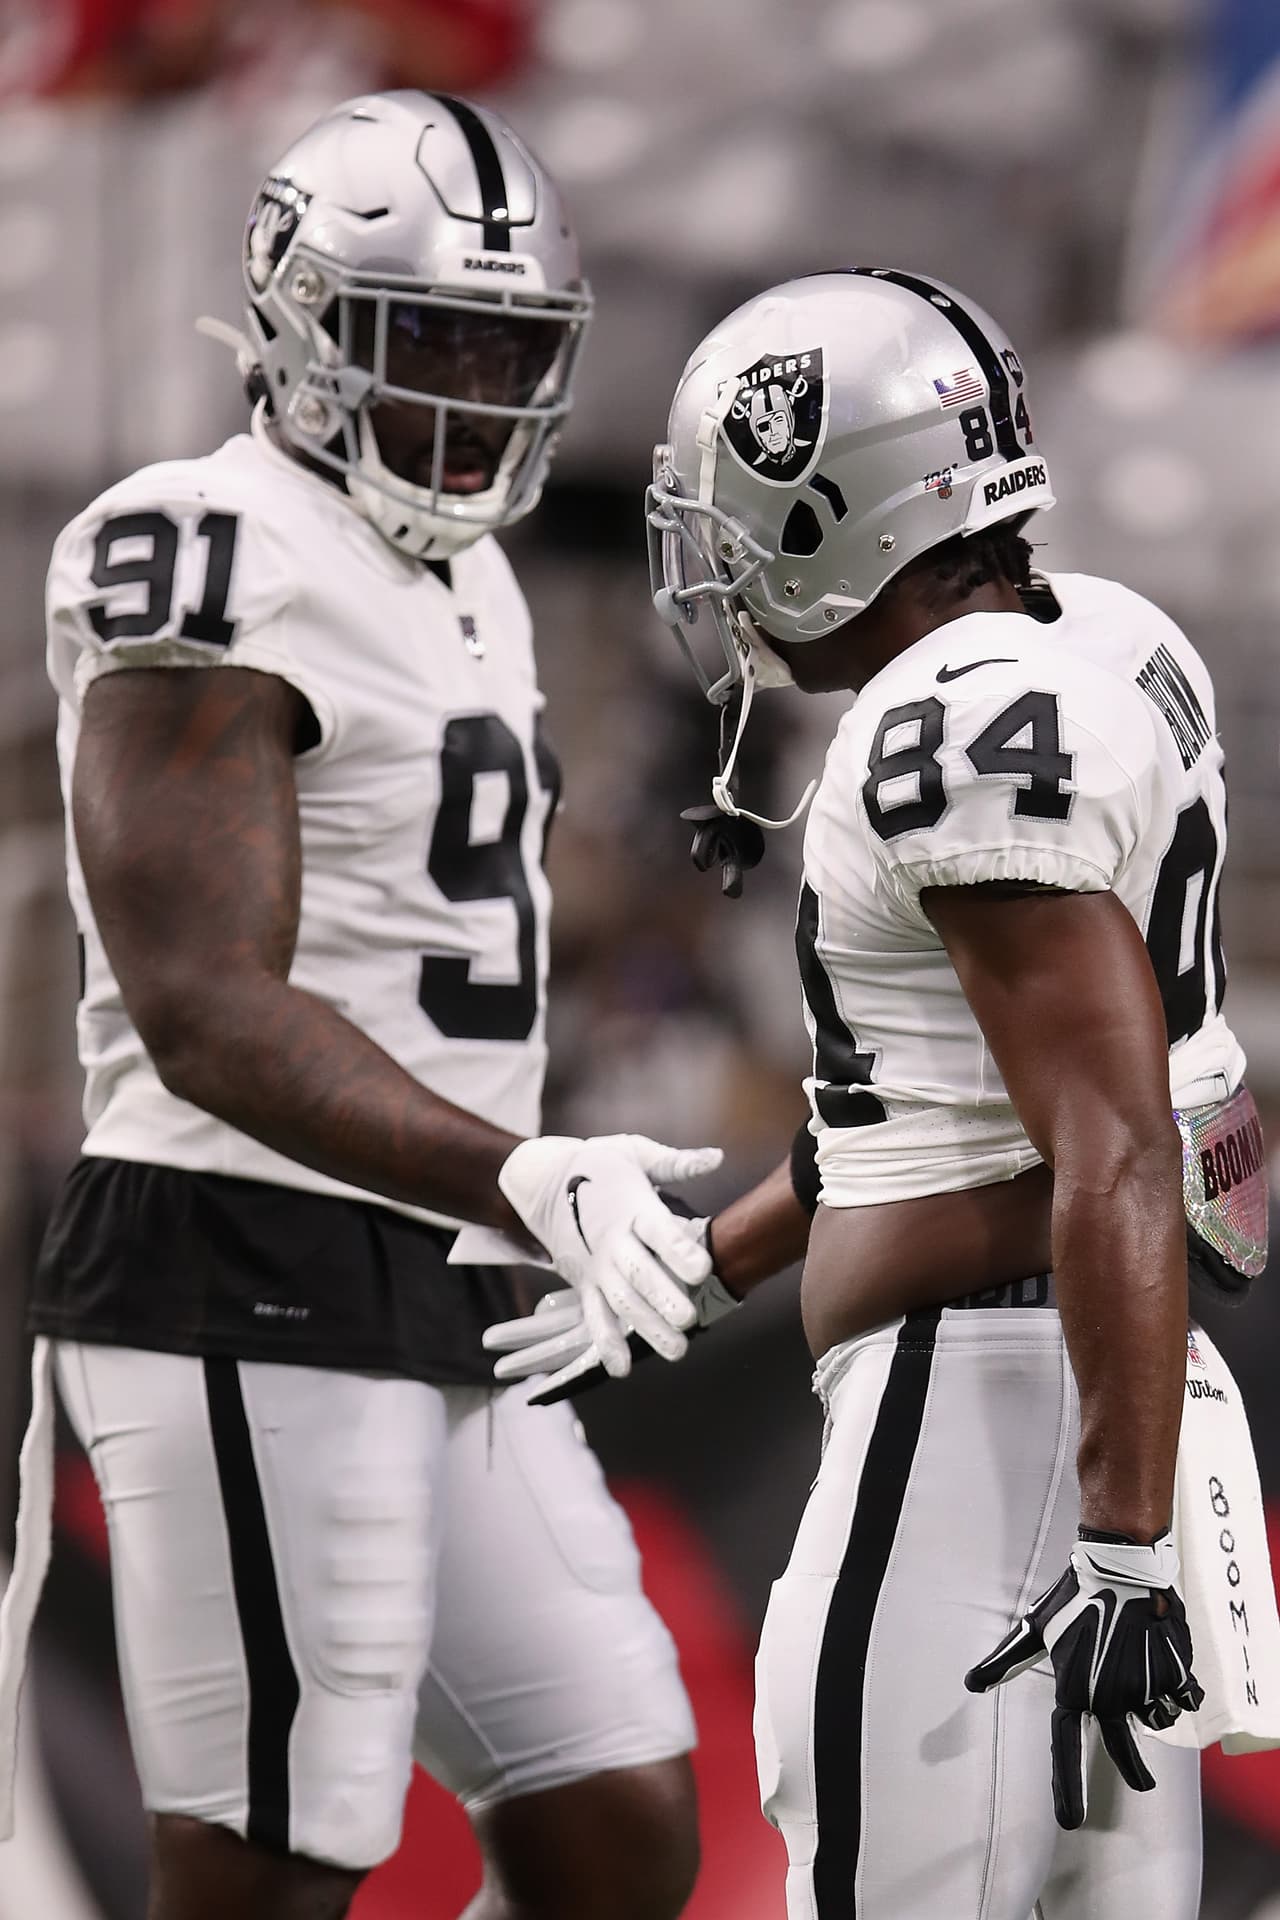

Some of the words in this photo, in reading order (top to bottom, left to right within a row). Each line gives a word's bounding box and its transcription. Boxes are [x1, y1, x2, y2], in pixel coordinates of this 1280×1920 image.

[463, 258, 525, 275] RAIDERS
[736, 353, 812, 390] AIDERS
[983, 464, 1047, 506] RAIDERS
[88, 511, 242, 647] 91
[861, 689, 1076, 842] 84
[1200, 1115, 1264, 1202] BOOMIN
[1208, 1475, 1259, 1707] BOOMIN
